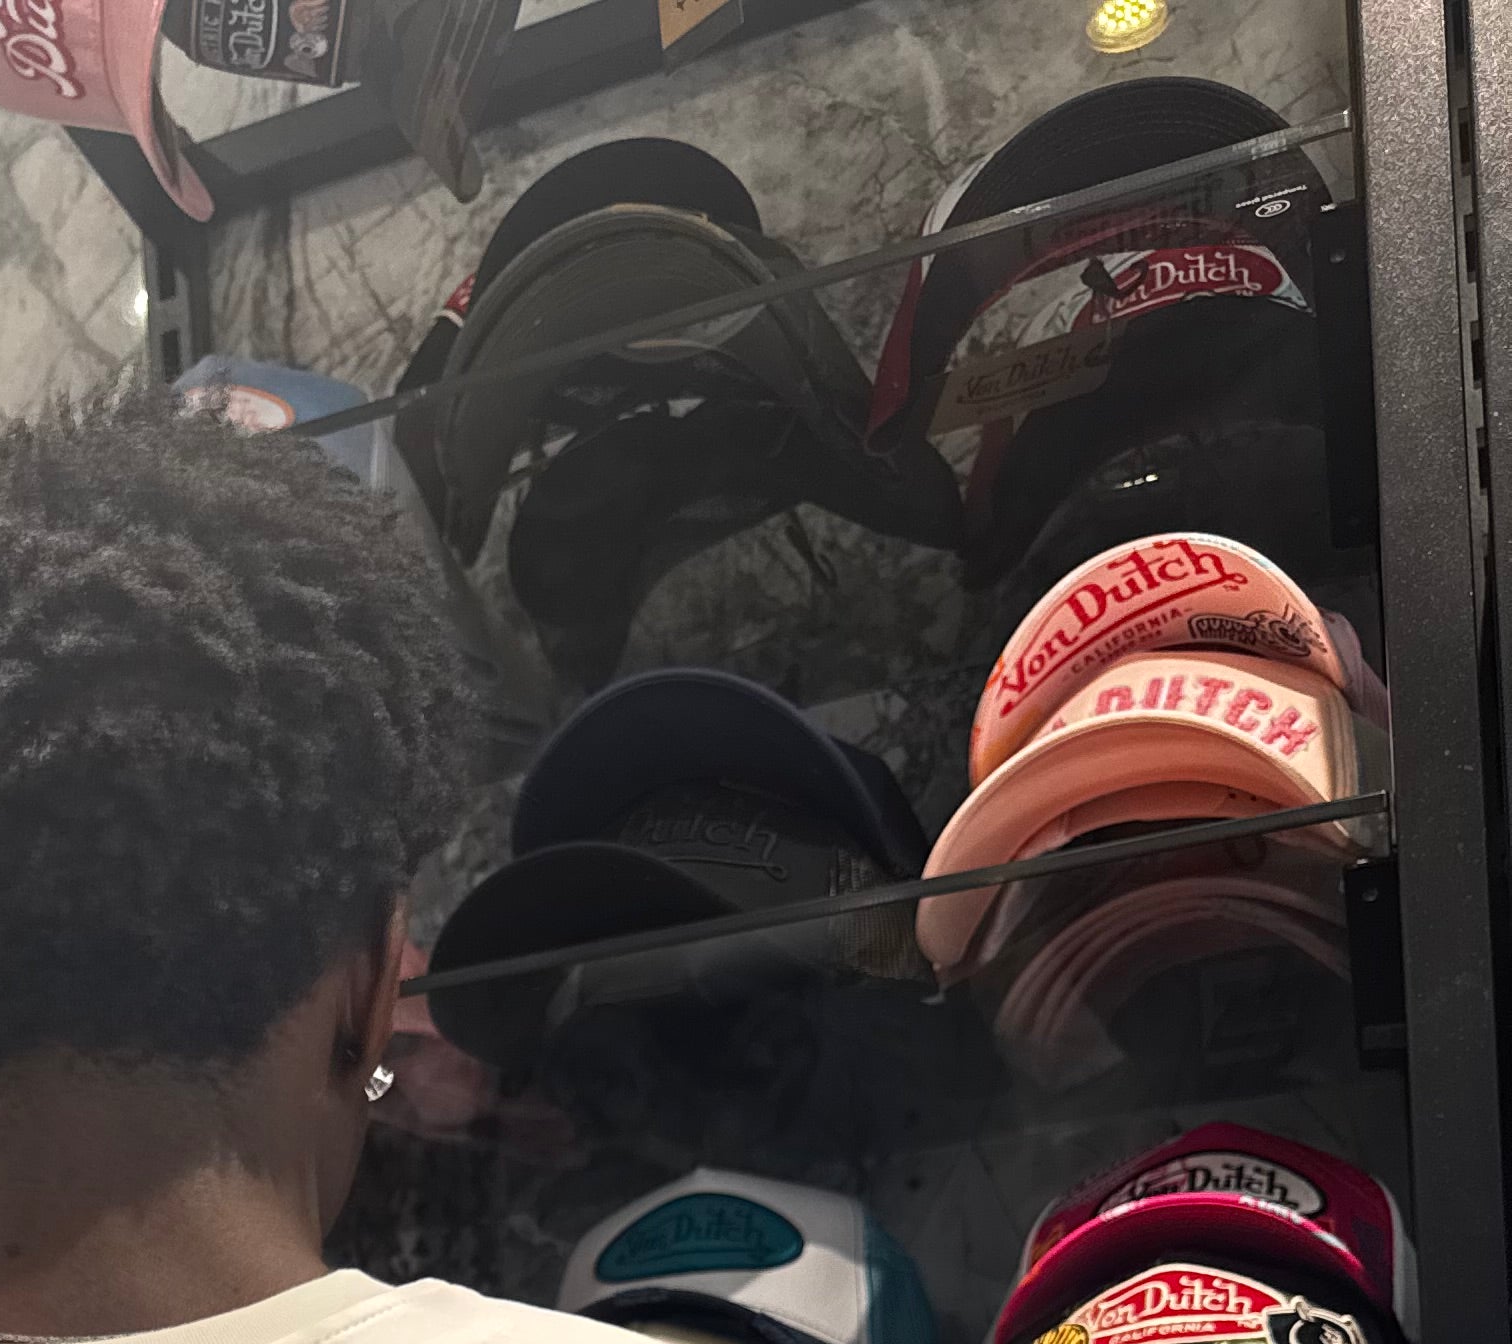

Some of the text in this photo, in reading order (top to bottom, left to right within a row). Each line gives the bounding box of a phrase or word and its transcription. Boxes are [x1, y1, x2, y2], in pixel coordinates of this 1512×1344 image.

[1149, 252, 1262, 292] Dutch
[1000, 625, 1084, 694] Von
[1069, 539, 1235, 630] Dutch
[1071, 607, 1181, 674] CALIFORNIA
[1088, 1302, 1140, 1332] Von
[1138, 1275, 1255, 1318] Dutch
